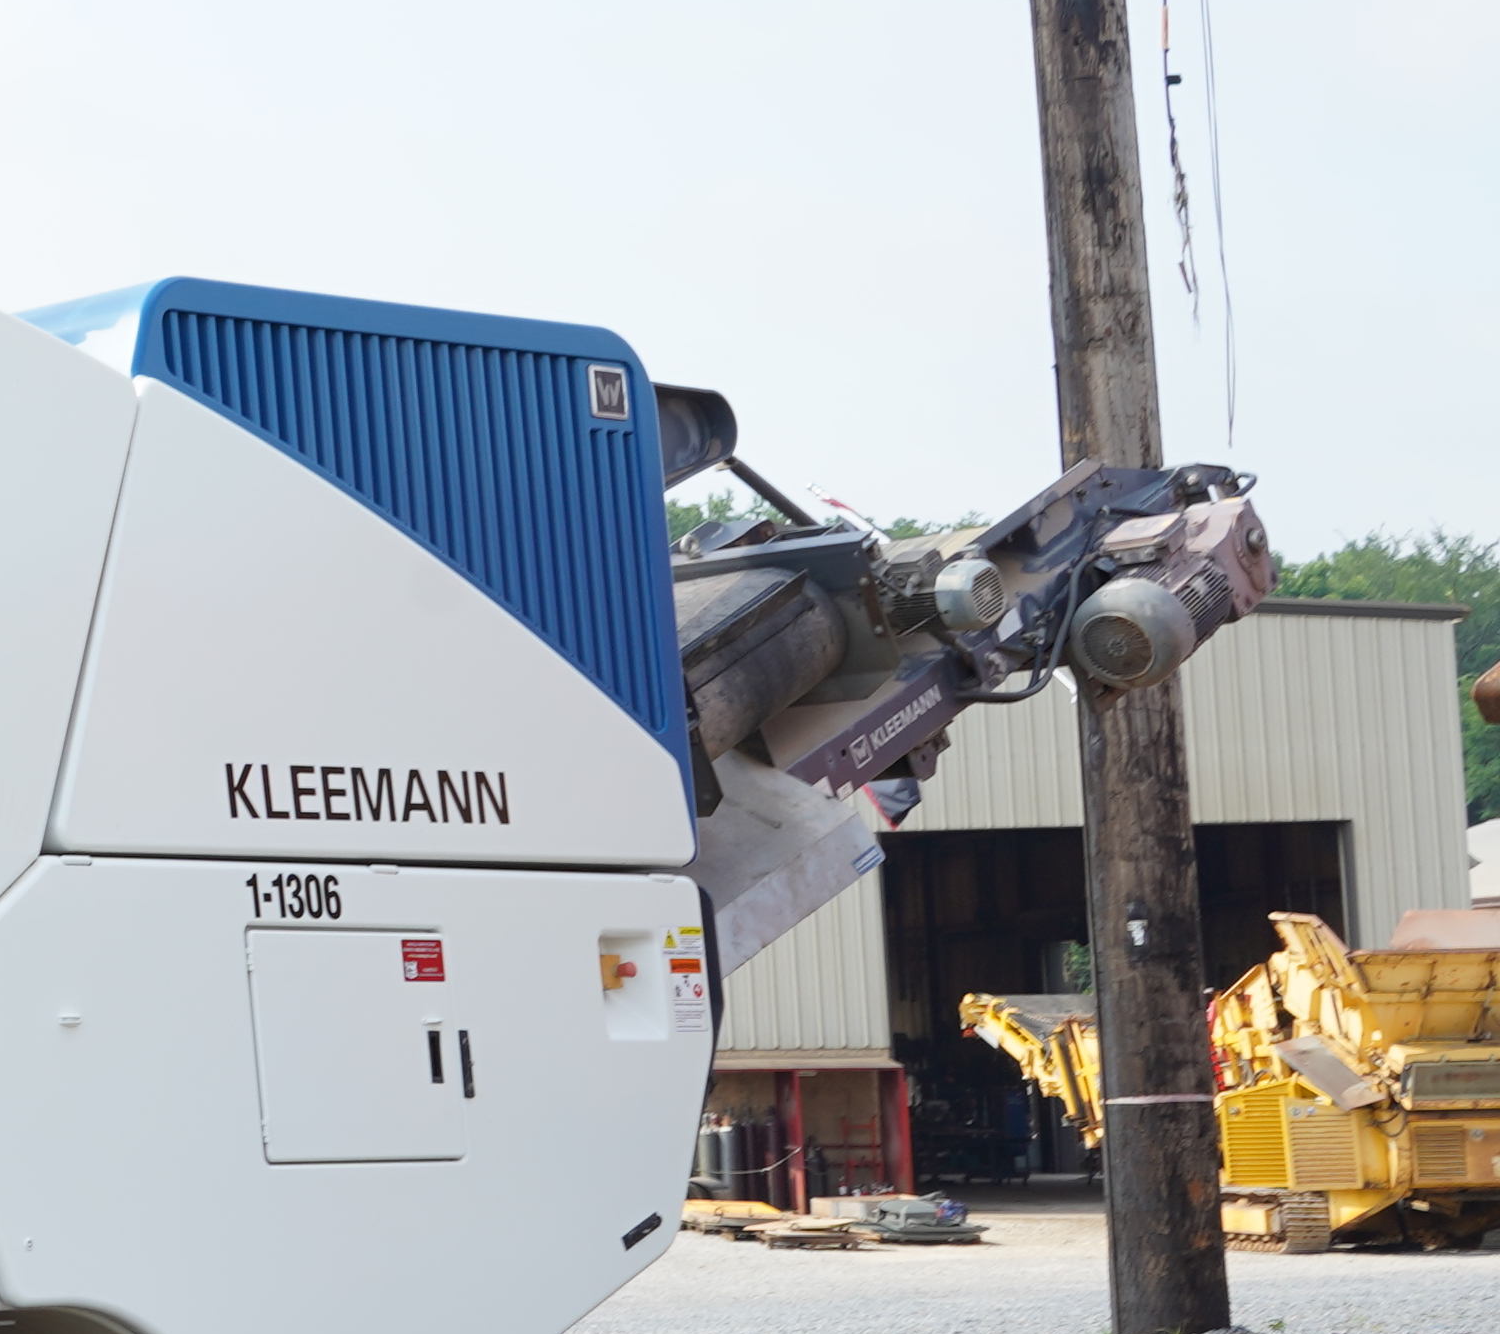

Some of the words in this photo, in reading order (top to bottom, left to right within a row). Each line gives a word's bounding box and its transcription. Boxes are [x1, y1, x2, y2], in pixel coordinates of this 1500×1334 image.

[869, 684, 942, 750] KLEEMANN
[224, 762, 511, 825] KLEEMANN
[245, 873, 342, 920] 1-1306
